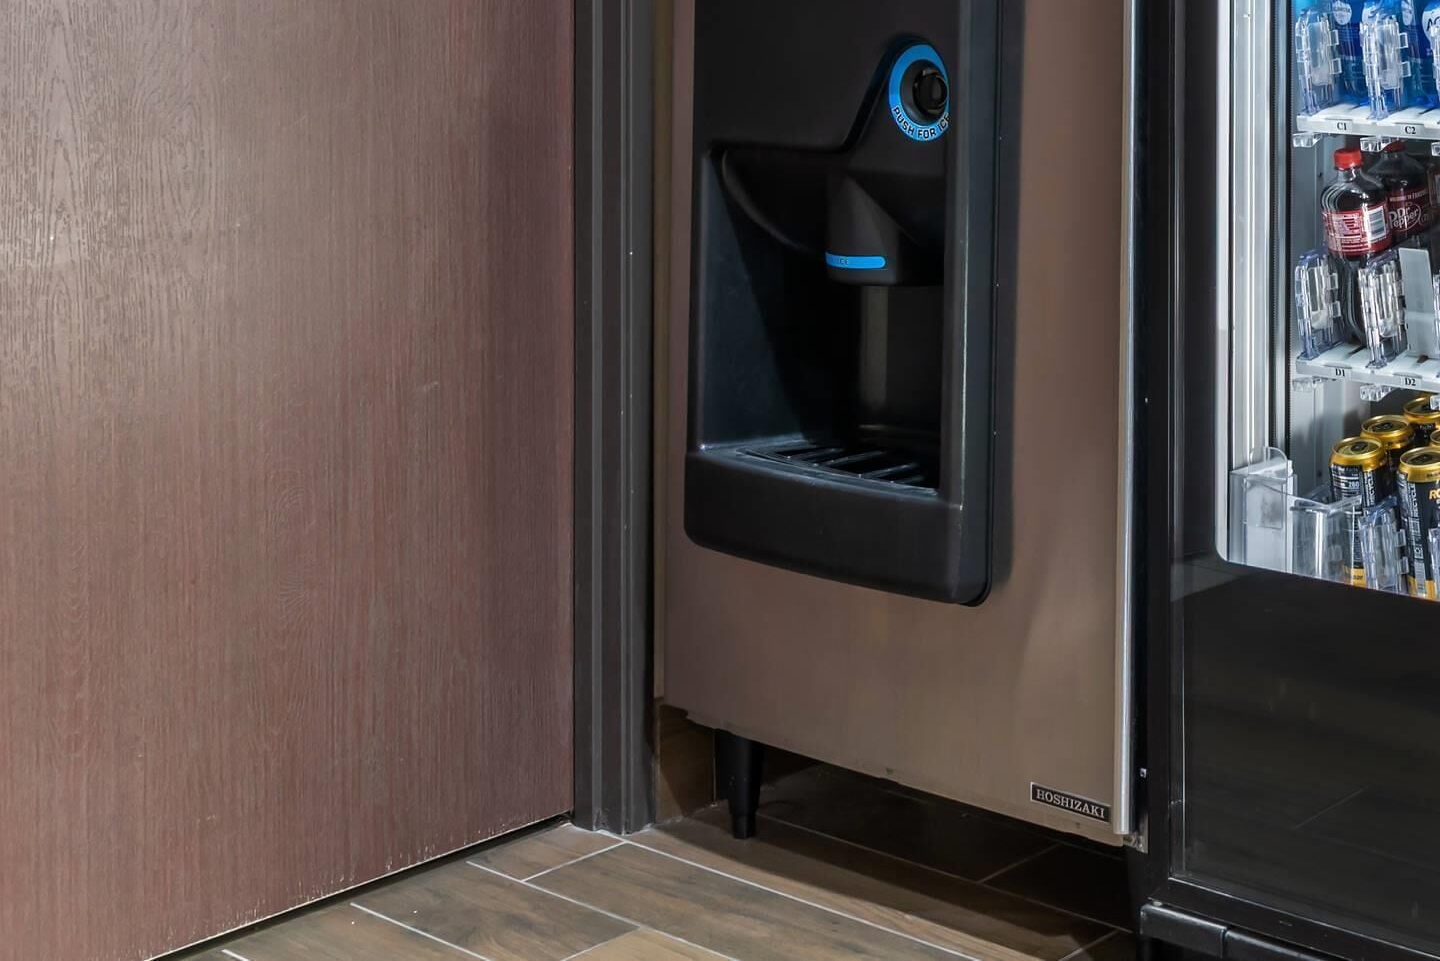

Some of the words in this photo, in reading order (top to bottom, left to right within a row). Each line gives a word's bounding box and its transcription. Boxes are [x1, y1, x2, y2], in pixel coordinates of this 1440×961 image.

[892, 106, 914, 136] PUSH
[918, 128, 936, 138] FOR
[1337, 122, 1348, 130] C1
[1404, 125, 1416, 134] C2
[1335, 368, 1346, 377] D1
[1404, 378, 1416, 386] D2
[1036, 788, 1104, 818] HOSHIZAKI
